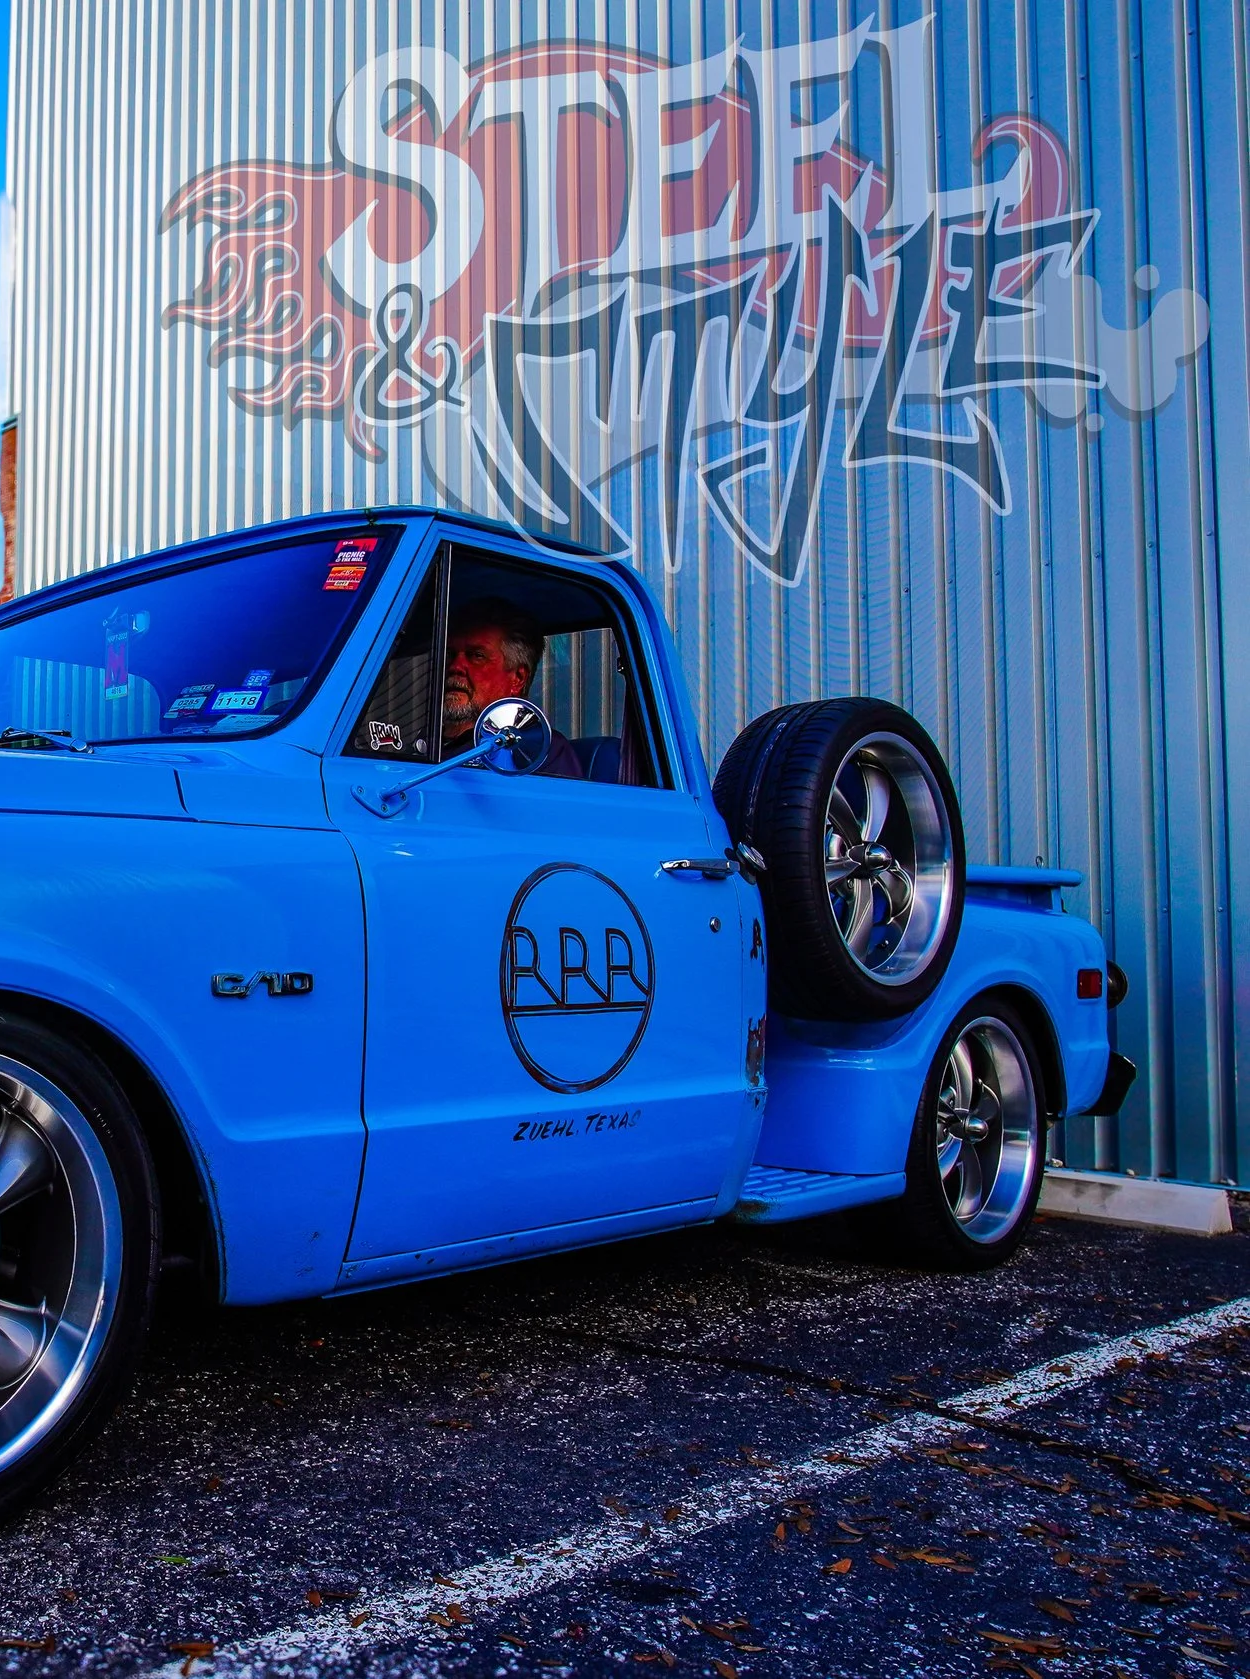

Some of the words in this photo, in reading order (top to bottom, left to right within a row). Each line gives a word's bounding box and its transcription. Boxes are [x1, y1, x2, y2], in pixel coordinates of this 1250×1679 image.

[337, 551, 366, 559] PICNIC
[247, 675, 268, 683] SEP
[507, 925, 652, 1008] RRR
[585, 1109, 642, 1134] TEXAS
